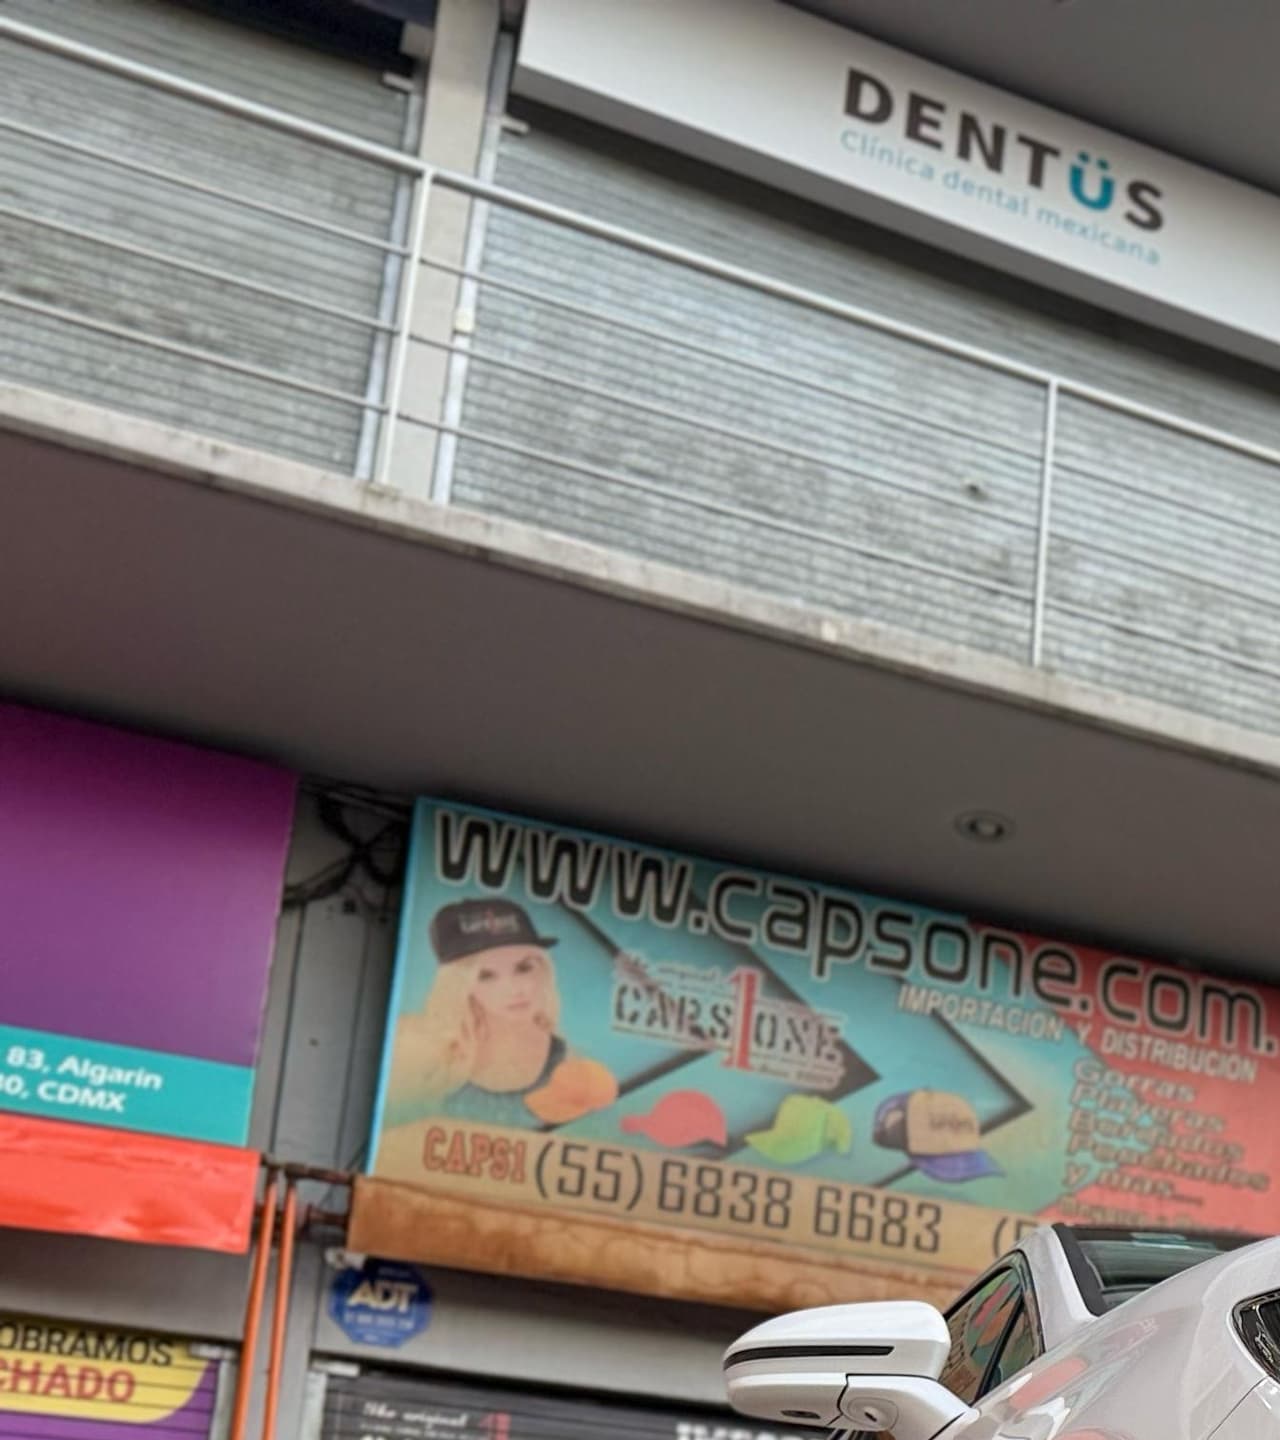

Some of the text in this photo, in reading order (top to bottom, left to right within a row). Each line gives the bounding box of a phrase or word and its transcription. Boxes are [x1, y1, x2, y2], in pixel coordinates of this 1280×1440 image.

[843, 66, 1164, 232] DENTÜS
[840, 129, 1160, 266] Clínica dental mexicana
[1076, 1021, 1092, 1046] Y
[6, 1045, 51, 1073] 83,
[1073, 1056, 1196, 1102] Gorras
[0, 1072, 126, 1112] 0, CDMX
[1070, 1083, 1226, 1131] Playeras
[1068, 1107, 1245, 1162] Bordados
[422, 1127, 527, 1182] CAPS1
[536, 1140, 643, 1211] (55)
[657, 1160, 793, 1231] 6838
[814, 1184, 942, 1254] 6683
[346, 1280, 419, 1313] ADT
